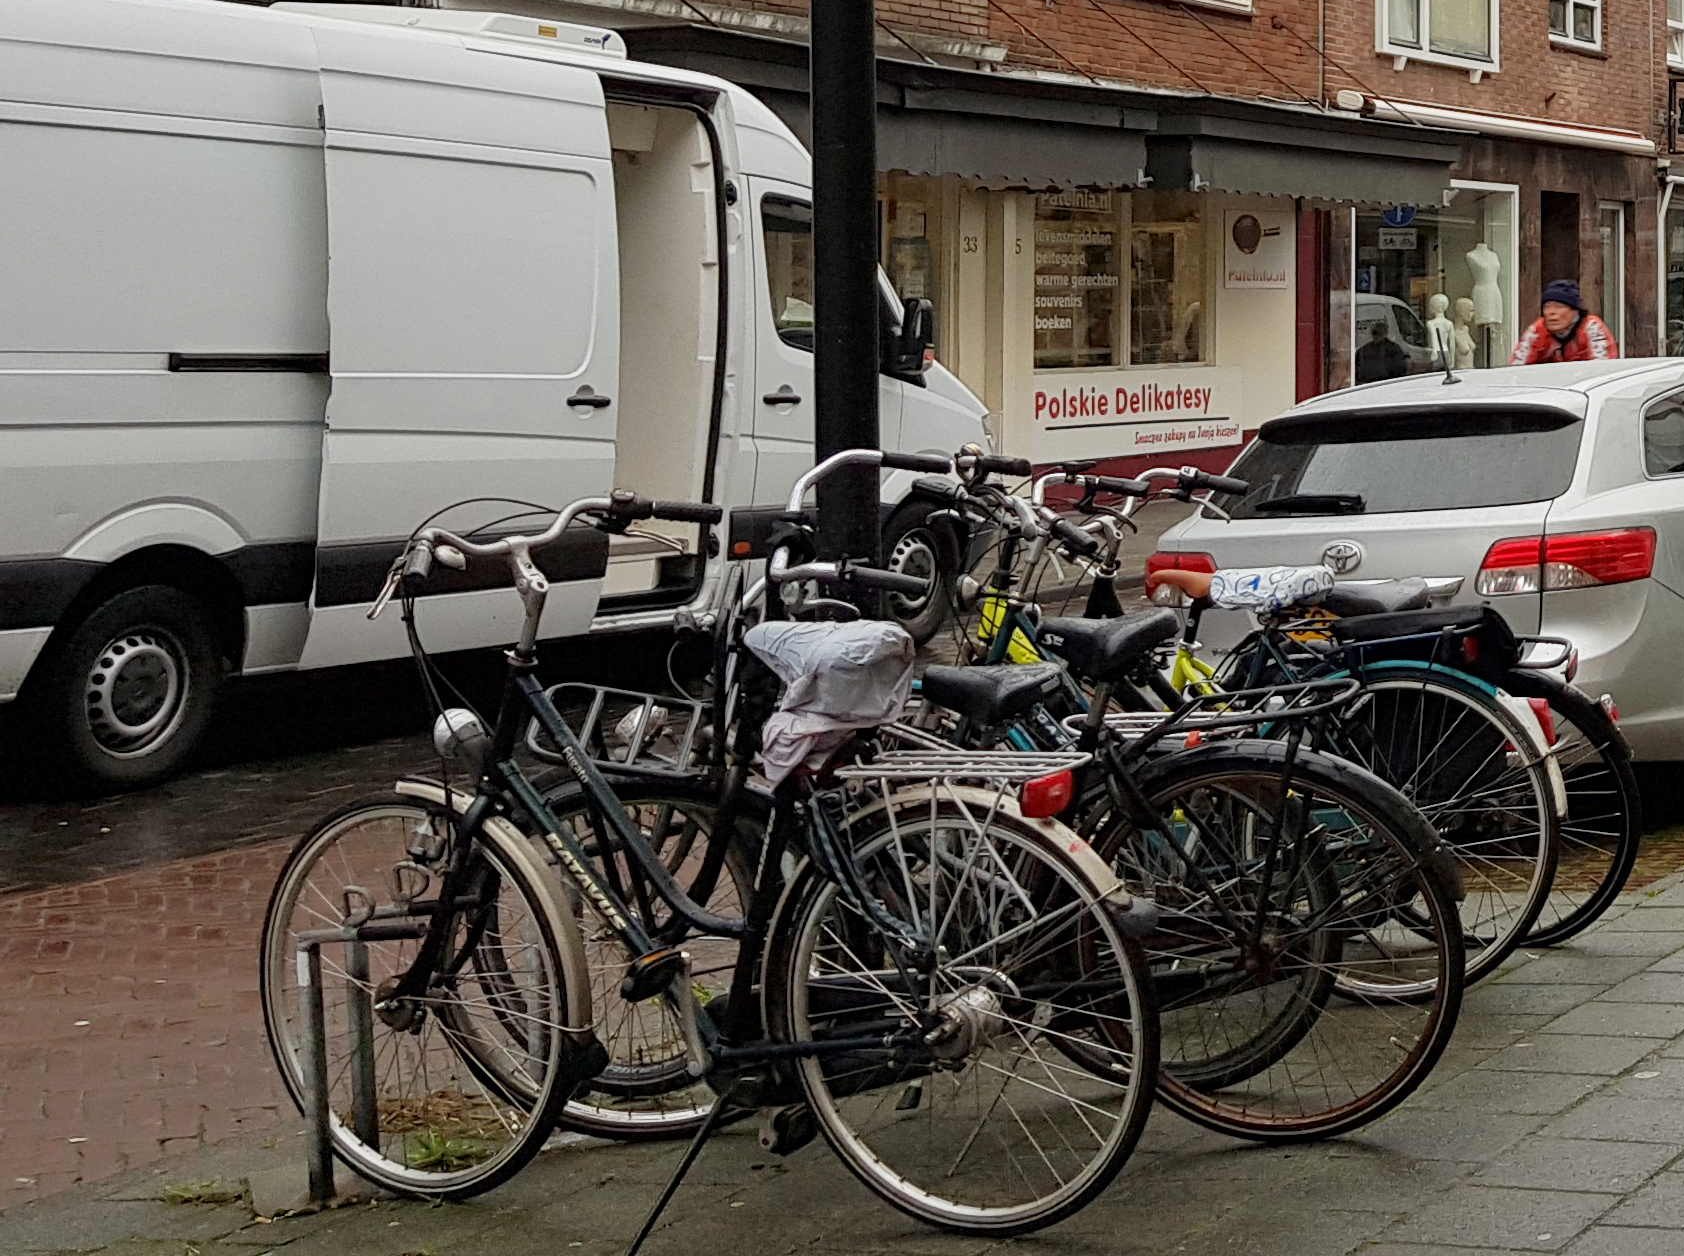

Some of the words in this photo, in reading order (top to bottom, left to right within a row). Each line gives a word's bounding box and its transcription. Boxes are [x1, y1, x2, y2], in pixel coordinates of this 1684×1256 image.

[1035, 228, 1112, 244] levensmiddelen
[963, 236, 978, 253] 33
[1035, 275, 1069, 286] warme
[1071, 273, 1119, 289] gerechten
[1035, 295, 1083, 308] souvenirs
[1035, 314, 1072, 329] boeken
[1035, 386, 1108, 420] Polskie
[1115, 382, 1212, 414] Delikatesy
[546, 832, 627, 930] BATAVUS
